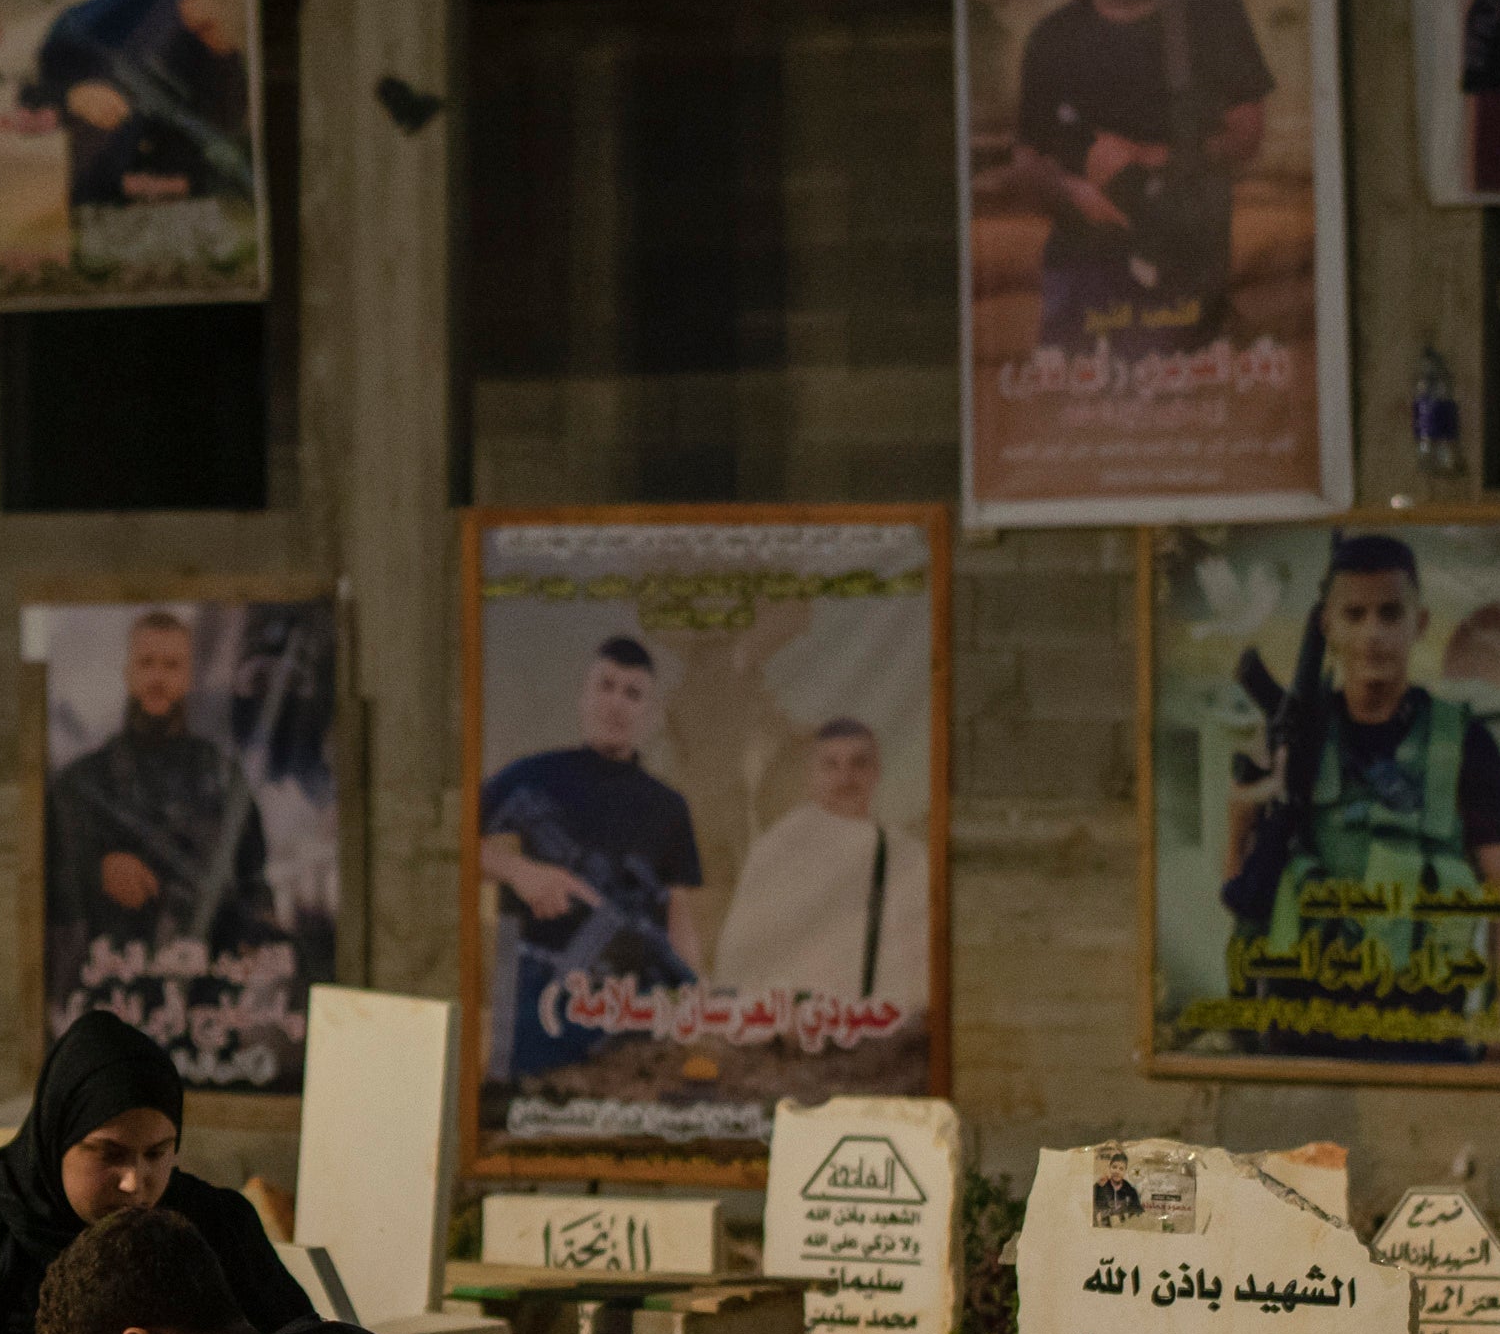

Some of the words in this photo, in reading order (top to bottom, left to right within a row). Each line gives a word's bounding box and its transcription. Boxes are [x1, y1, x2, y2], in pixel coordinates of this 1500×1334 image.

[1082, 1257, 1141, 1297] الله
[1151, 1262, 1222, 1312] باذن
[1234, 1264, 1356, 1314] الشهيد
